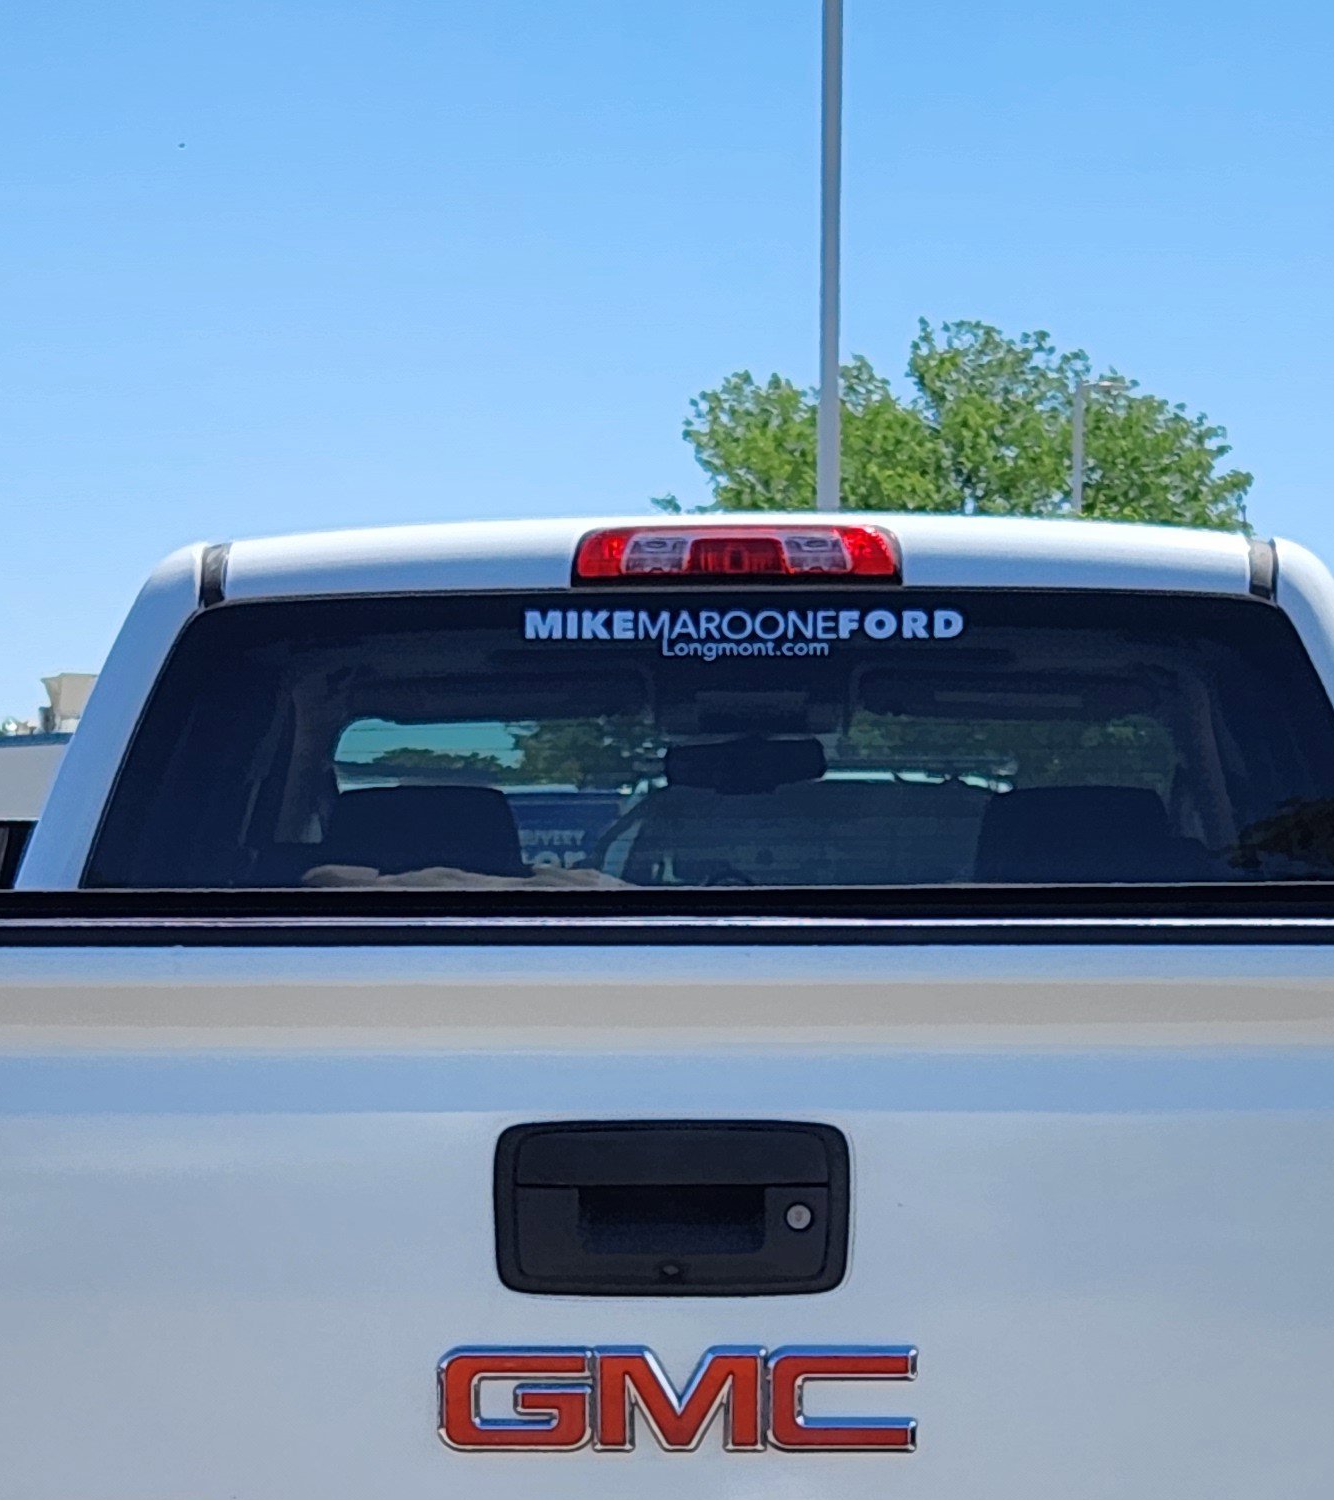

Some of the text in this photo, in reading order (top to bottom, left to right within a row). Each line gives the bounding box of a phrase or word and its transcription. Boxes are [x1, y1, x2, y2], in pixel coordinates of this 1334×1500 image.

[524, 609, 964, 640] MIKEMAROONEFORD
[662, 640, 829, 661] Longmont.com
[437, 1345, 918, 1452] GMC
